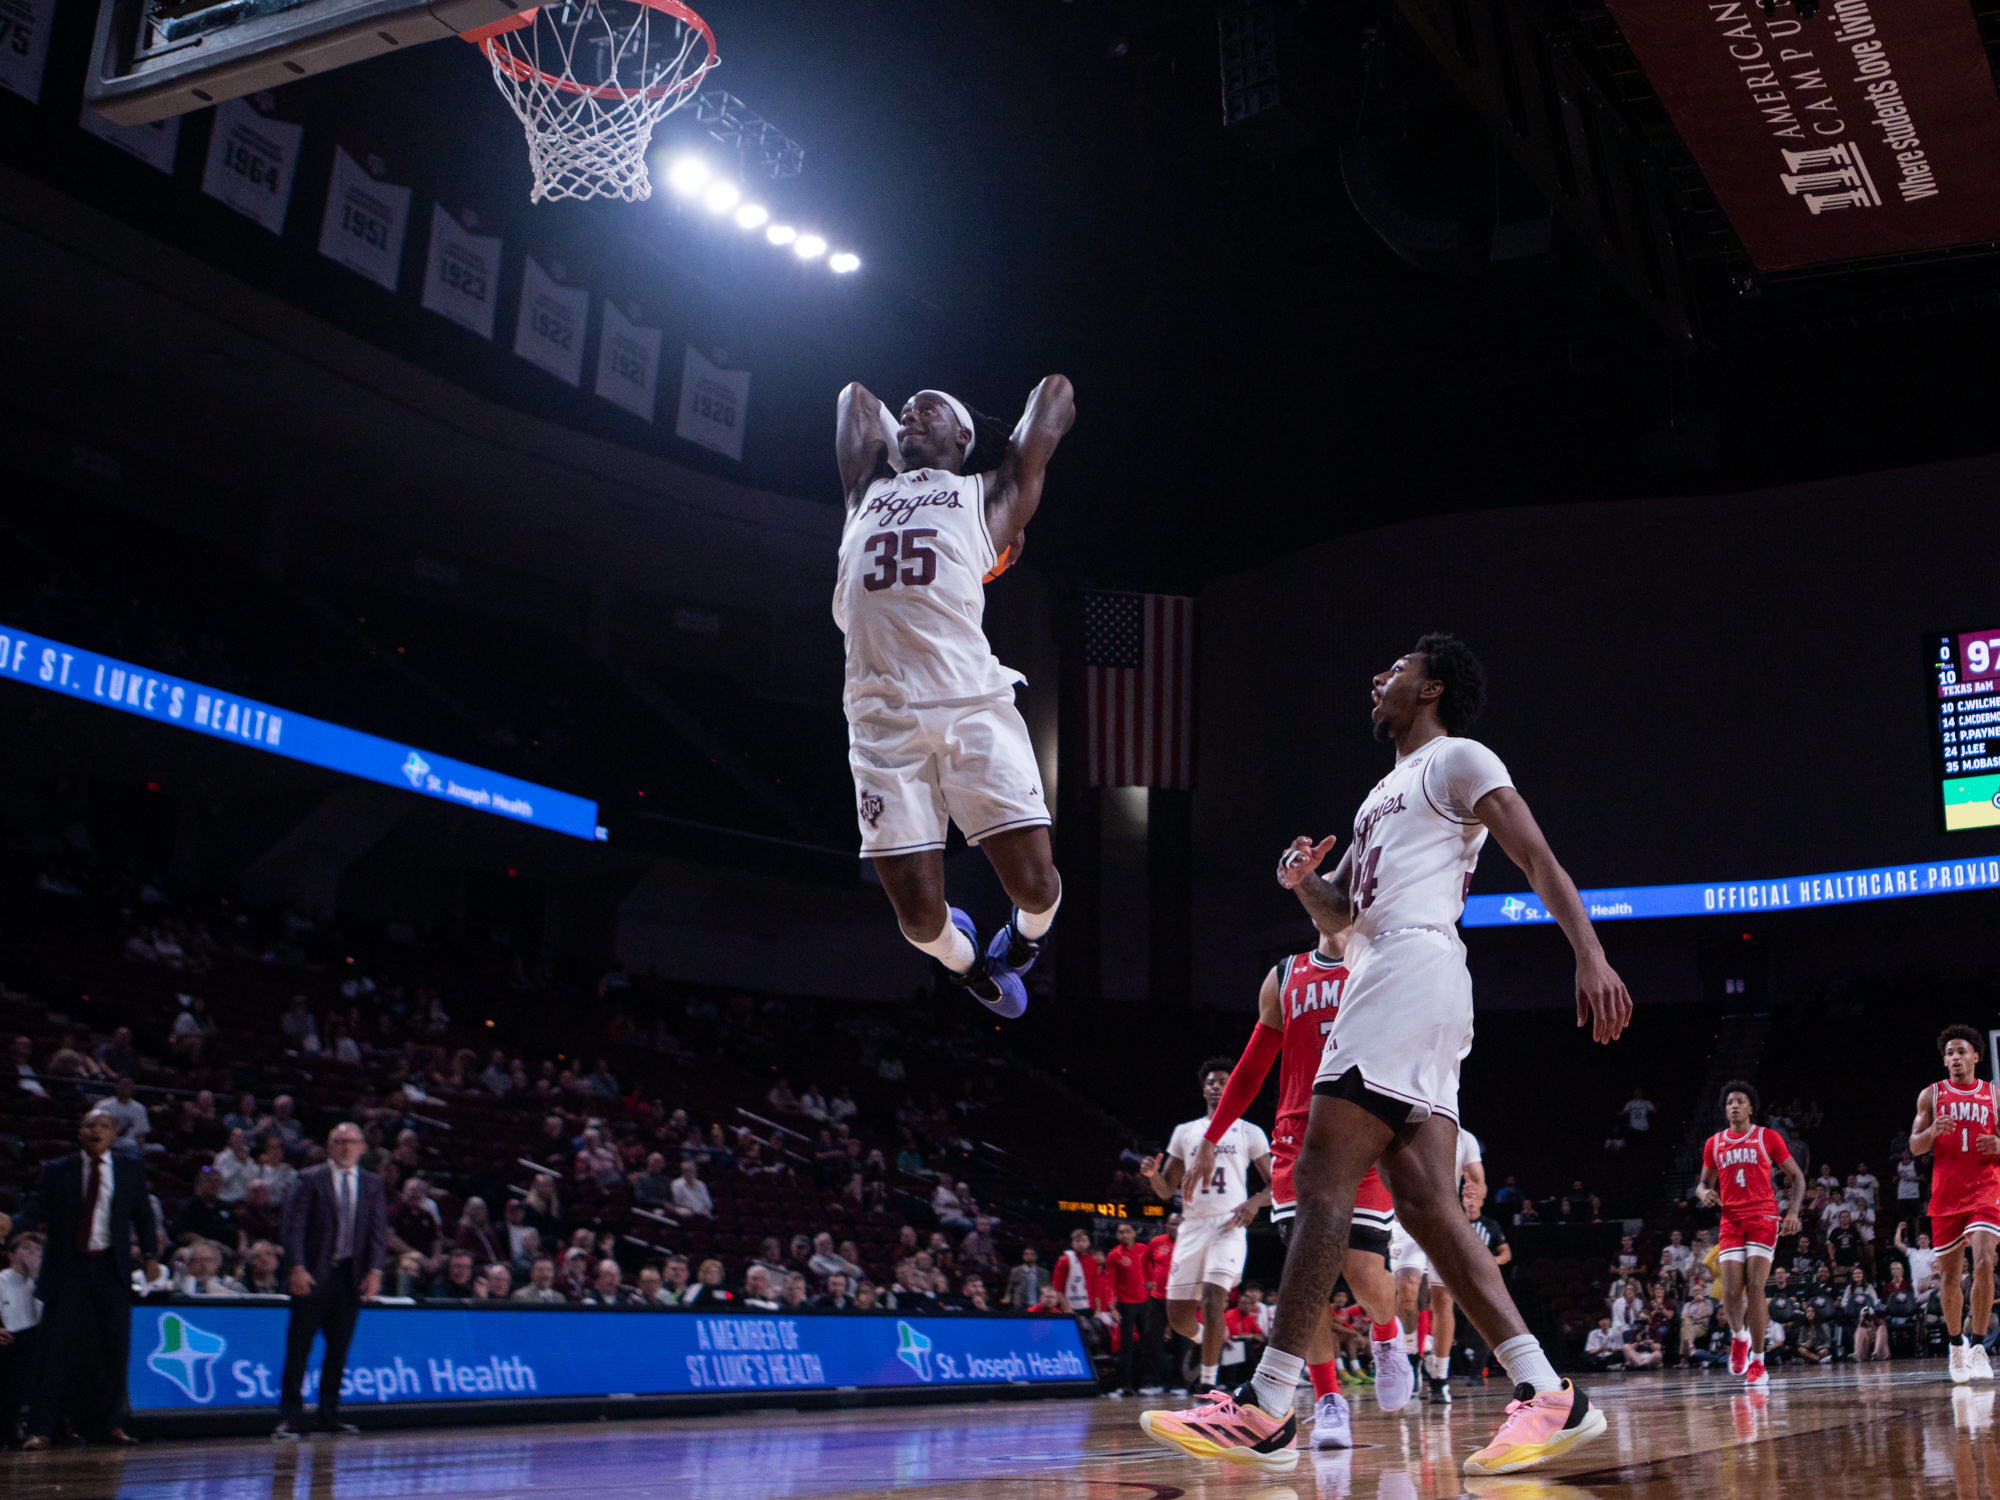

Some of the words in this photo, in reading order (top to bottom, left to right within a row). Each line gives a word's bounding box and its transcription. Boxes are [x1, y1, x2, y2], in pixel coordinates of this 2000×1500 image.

[1708, 1, 1806, 139] AMERICAN
[1755, 0, 1846, 136] CAMPU
[1850, 39, 1892, 83] love
[1864, 78, 1921, 151] students
[224, 140, 279, 193] 1964
[1897, 149, 1940, 202] Where
[342, 202, 388, 250] 1951
[859, 489, 965, 527] Aggies
[863, 527, 939, 592] 35
[1940, 645, 1950, 661] 0
[1938, 670, 1957, 686] 10
[1942, 683, 1973, 697] TEXAS
[1974, 680, 1994, 694] A&M
[39, 648, 80, 690] ST.
[94, 663, 185, 718] LUKE'S
[194, 692, 282, 745] HEALTH
[1941, 702, 1955, 715] 10
[1942, 717, 1956, 730] 14
[1943, 731, 1957, 744] 21
[1944, 746, 1958, 759] 24
[1960, 742, 1986, 757] J.LEE
[1946, 761, 1959, 773] 35
[1704, 884, 1791, 910] OFFICIAL
[1800, 869, 1918, 903] HEALTHCARE
[1928, 861, 1999, 889] PROVID
[1525, 907, 1541, 919] St.
[1591, 902, 1632, 916] Health
[1961, 1127, 1969, 1152] 1
[1719, 1147, 1758, 1169] LAMAR
[1735, 1168, 1747, 1188] 4
[428, 1355, 538, 1392] Health
[936, 1352, 964, 1379] St.
[965, 1351, 1028, 1383] Joseph
[1026, 1350, 1085, 1377] Health
